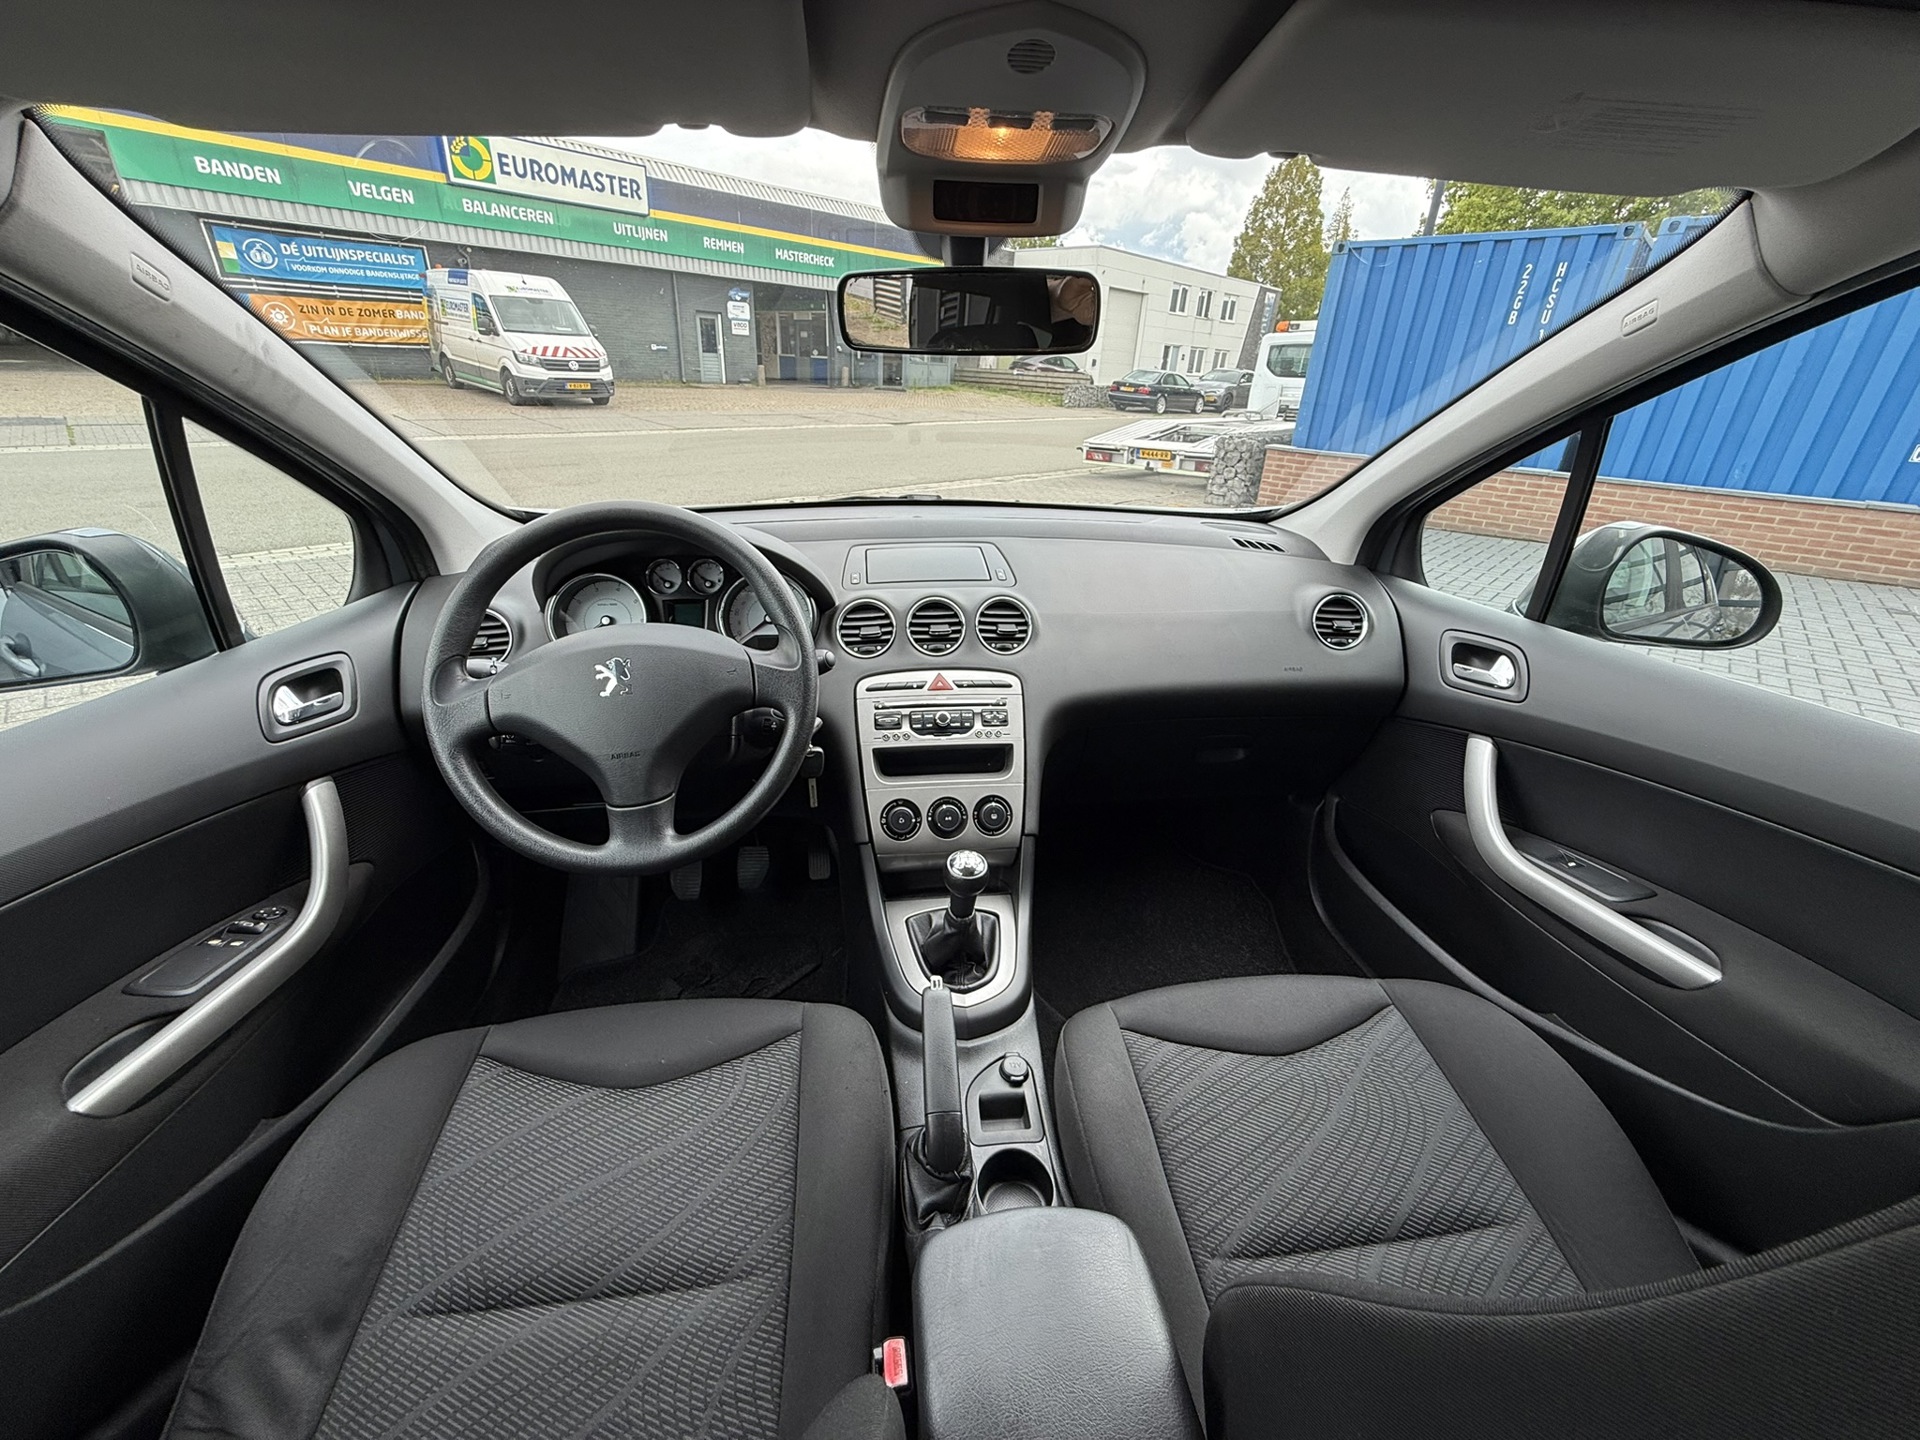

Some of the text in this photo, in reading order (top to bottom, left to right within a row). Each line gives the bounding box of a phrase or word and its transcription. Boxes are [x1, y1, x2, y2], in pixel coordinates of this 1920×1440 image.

[193, 155, 282, 185] BANDEN
[496, 152, 643, 201] EUROMASTER
[347, 180, 415, 205] VELGEN
[461, 198, 555, 225] BALANCEREN
[612, 221, 669, 243] UITLIJNEN
[279, 241, 416, 266] DÉ UITLIJNSPECIALIST
[703, 236, 745, 254] REMMEN
[775, 247, 835, 268] MASTERCHECK
[291, 263, 420, 281] VOORKOM ONNODIGE BANDENSLIJTAGE
[1541, 262, 1568, 325] HCSU
[299, 304, 320, 315] ZIN
[322, 306, 336, 316] IN
[339, 307, 354, 317] DE
[1623, 307, 1656, 329] AIRBAG
[309, 324, 340, 336] PLAN
[342, 326, 353, 337] JE
[611, 751, 641, 760] AIRBAG
